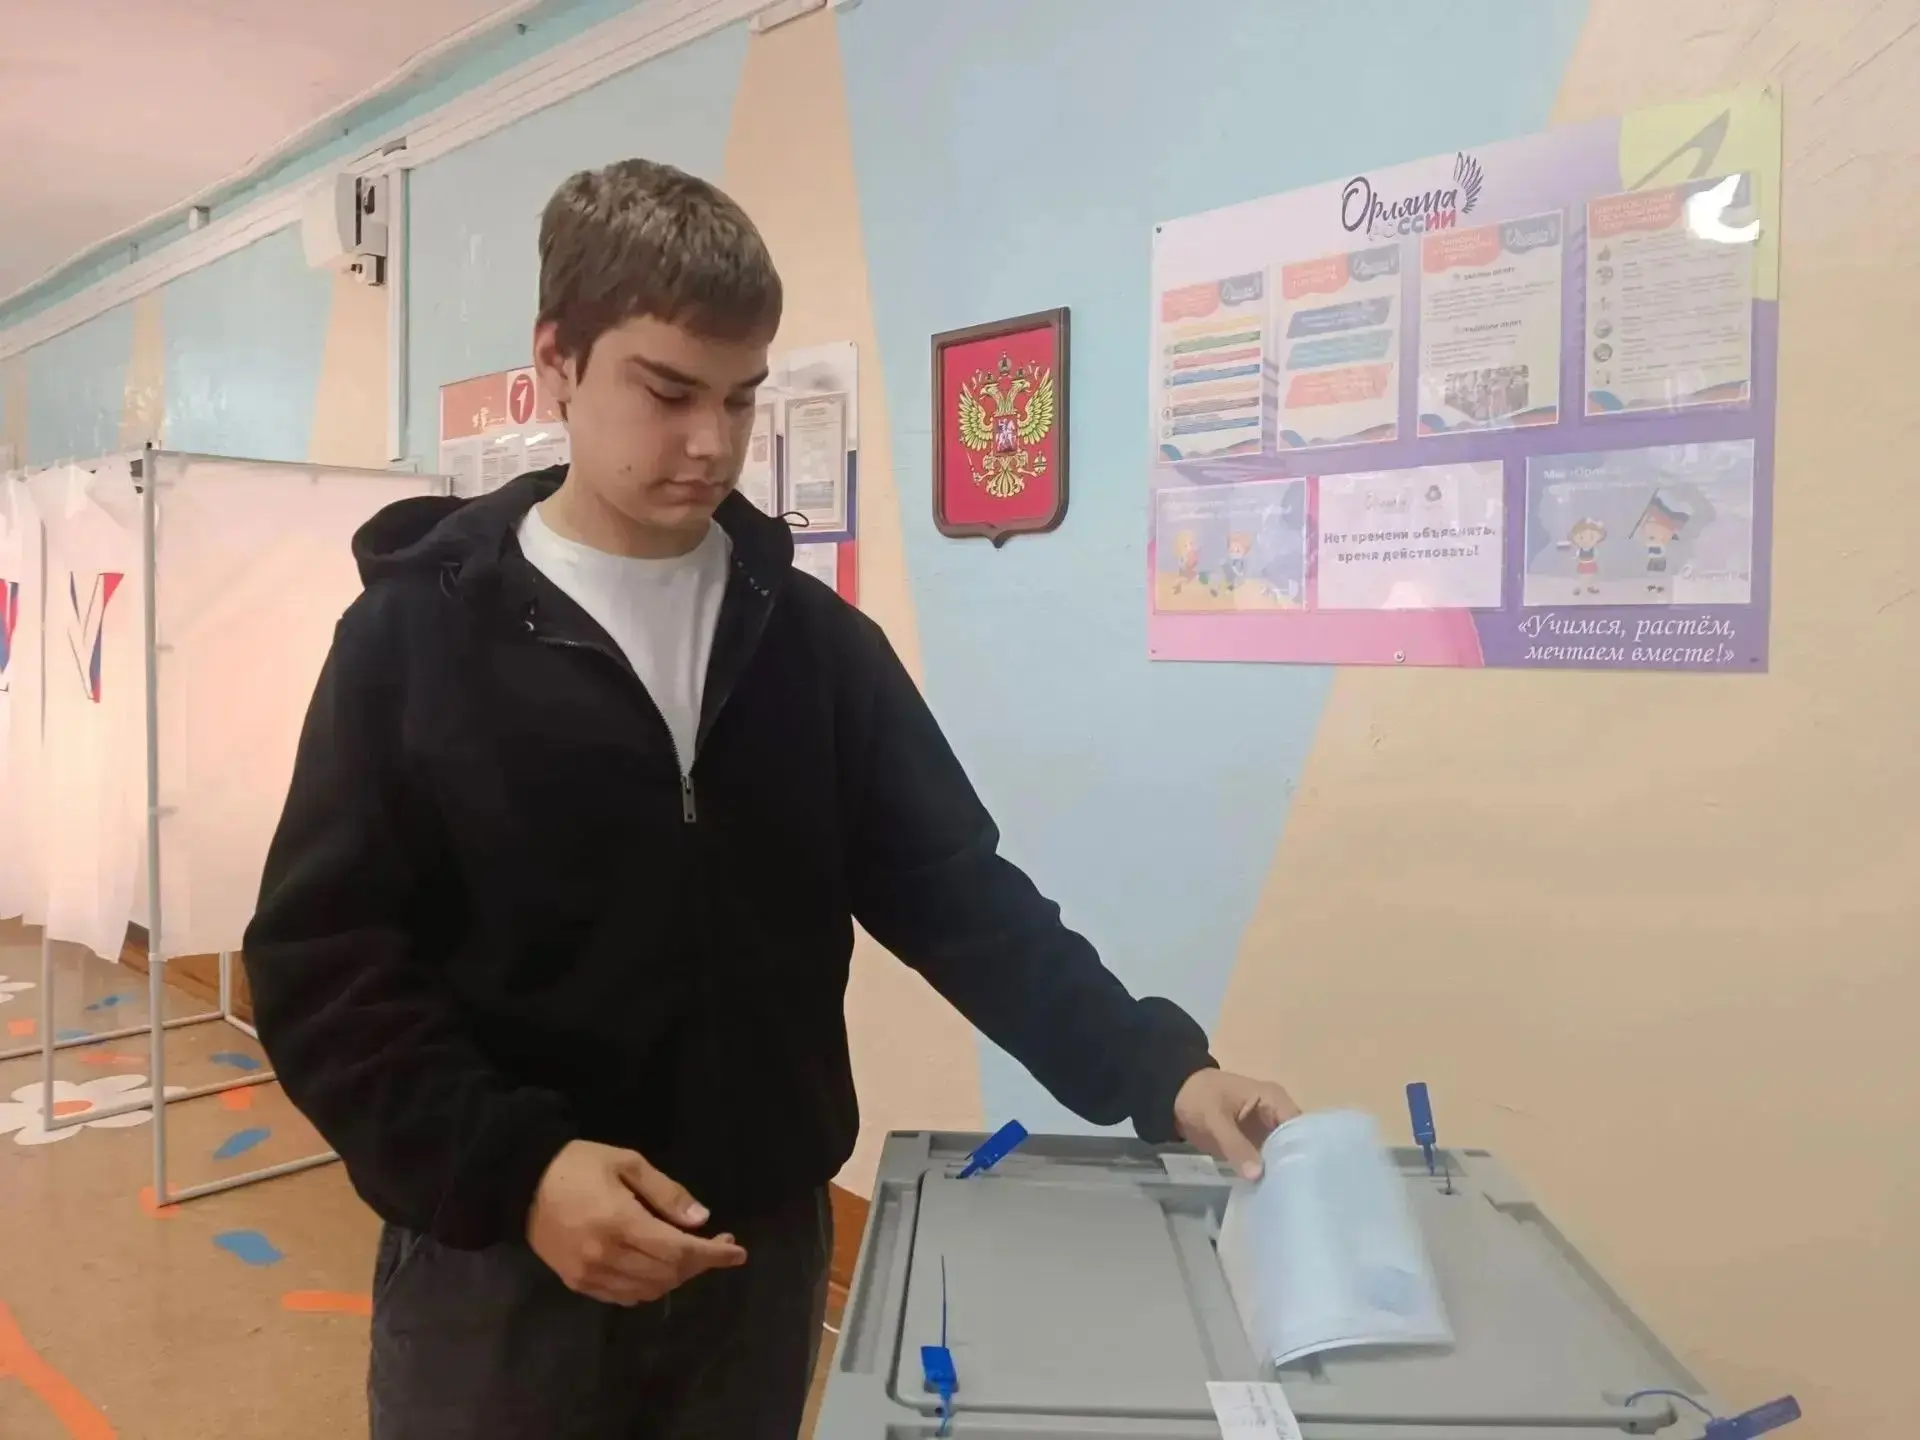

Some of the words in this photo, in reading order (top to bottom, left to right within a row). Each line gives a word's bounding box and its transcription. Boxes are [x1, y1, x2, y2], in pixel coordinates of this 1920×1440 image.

[1342, 176, 1457, 234] Орлята
[1324, 533, 1348, 544] Нет
[1352, 530, 1409, 544] времени
[1337, 550, 1379, 564] время
[1382, 545, 1479, 562] действовать!
[1518, 613, 1627, 639] «Учимся,
[1633, 615, 1736, 642] растём,
[1524, 645, 1625, 661] мечтаем
[1631, 643, 1736, 663] вместе!»
